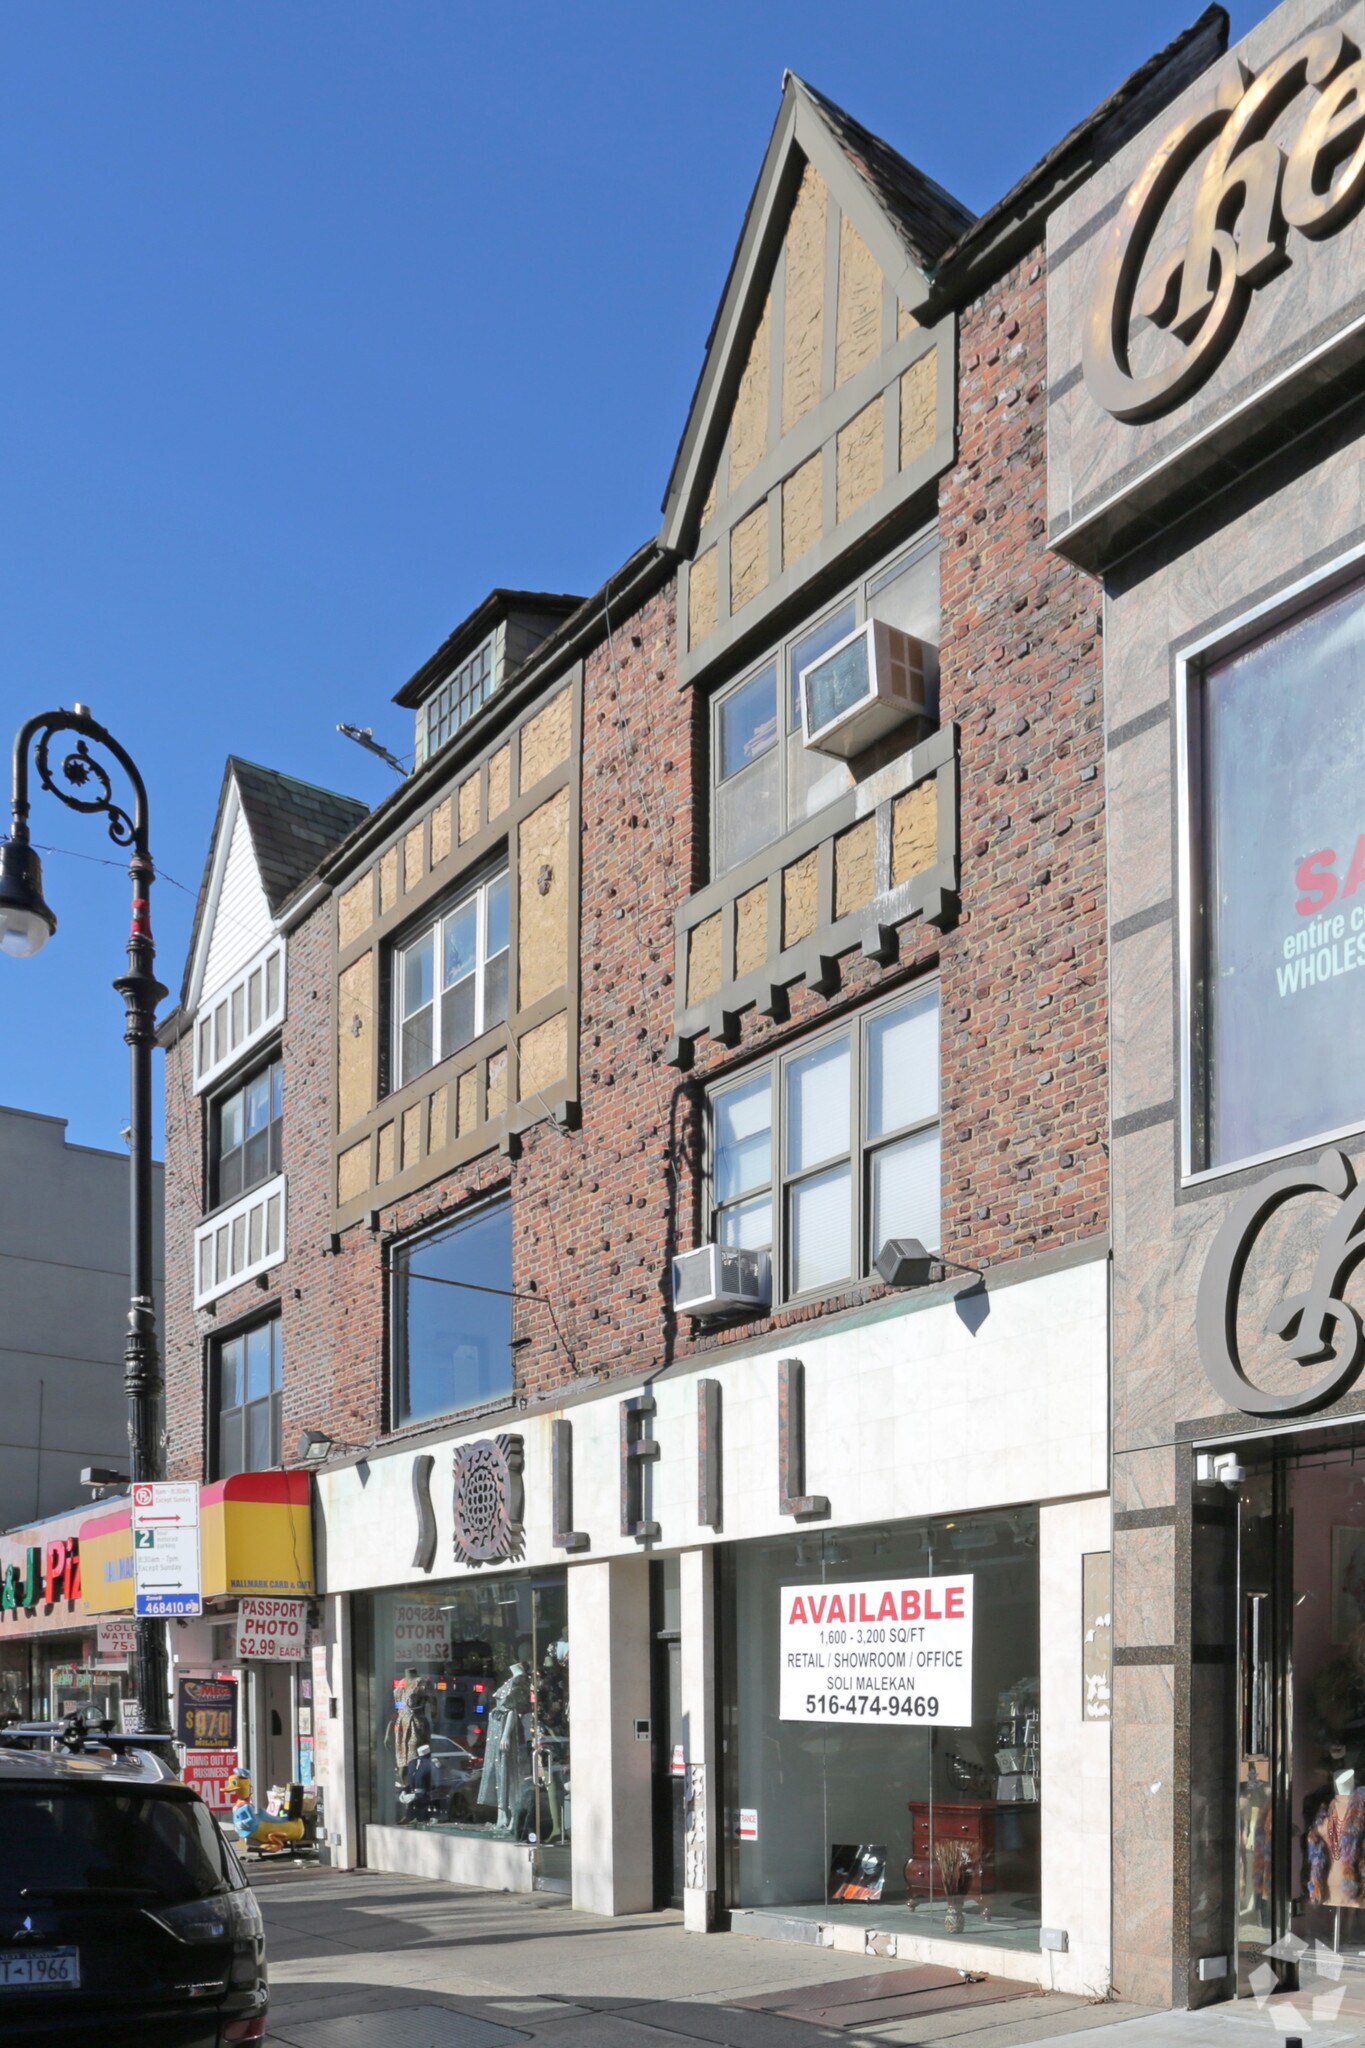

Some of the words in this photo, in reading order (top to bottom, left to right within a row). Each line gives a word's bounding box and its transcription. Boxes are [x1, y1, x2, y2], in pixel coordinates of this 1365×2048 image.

[1283, 914, 1345, 960] entire
[139, 1530, 150, 1548] 2
[231, 1579, 268, 1589] HALLMARK
[270, 1580, 289, 1589] CARD
[145, 1602, 184, 1614] 468410
[242, 1600, 305, 1619] PASSPORT
[789, 1586, 965, 1625] AVAILABLE
[245, 1619, 299, 1637] PHOTO
[819, 1630, 847, 1646] 1,600
[857, 1628, 886, 1645] 3,200
[889, 1627, 926, 1644] SQ/FT
[240, 1638, 276, 1657] $2.99
[280, 1646, 302, 1657] EACH
[787, 1653, 825, 1668] RETAIL
[834, 1651, 906, 1668] SHOWROOM
[916, 1650, 963, 1667] OFFICE
[827, 1676, 853, 1690] SOLI
[856, 1676, 915, 1691] MALEKAN
[806, 1694, 939, 1717] 516-474-9469
[186, 1755, 209, 1767] GOING
[210, 1755, 225, 1766] OUT
[226, 1754, 236, 1765] OF
[193, 1767, 228, 1779] BUSINESS
